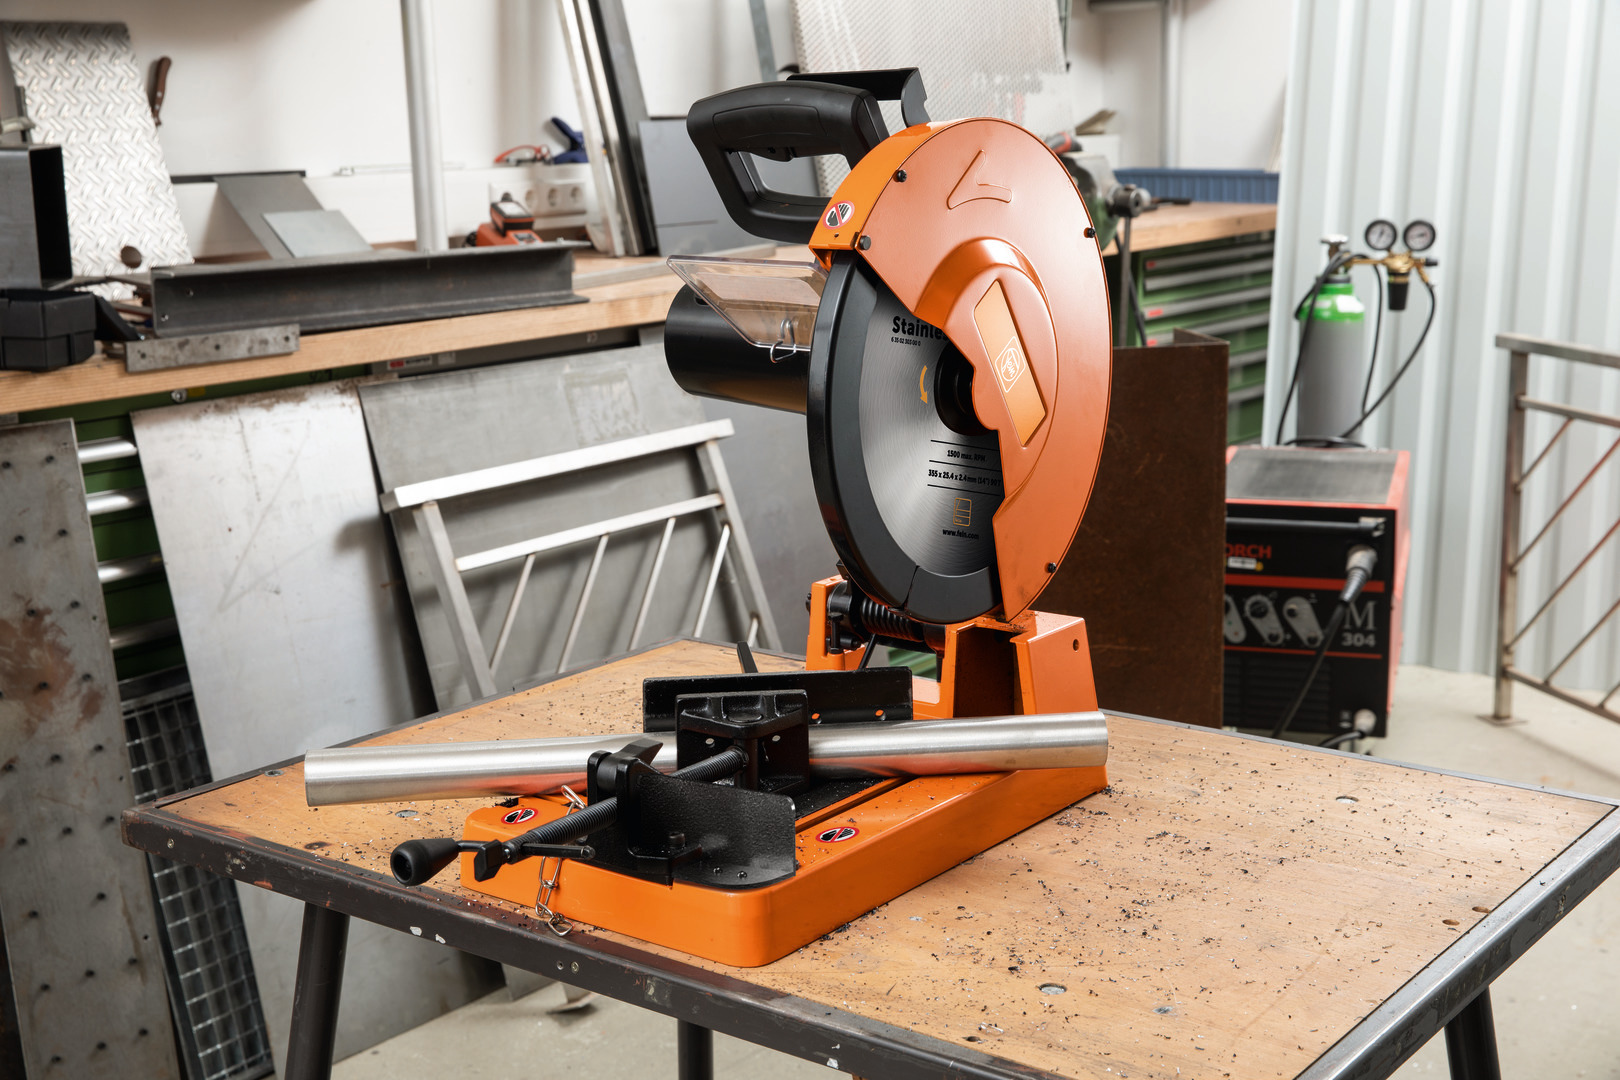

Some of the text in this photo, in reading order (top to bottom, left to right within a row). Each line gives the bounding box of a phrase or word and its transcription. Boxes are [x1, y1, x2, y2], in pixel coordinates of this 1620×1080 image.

[947, 450, 960, 458] 1500
[974, 453, 986, 462] RPM
[928, 469, 938, 477] 355
[943, 471, 954, 480] 25.4
[1343, 601, 1376, 630] M
[1341, 632, 1376, 647] 304
